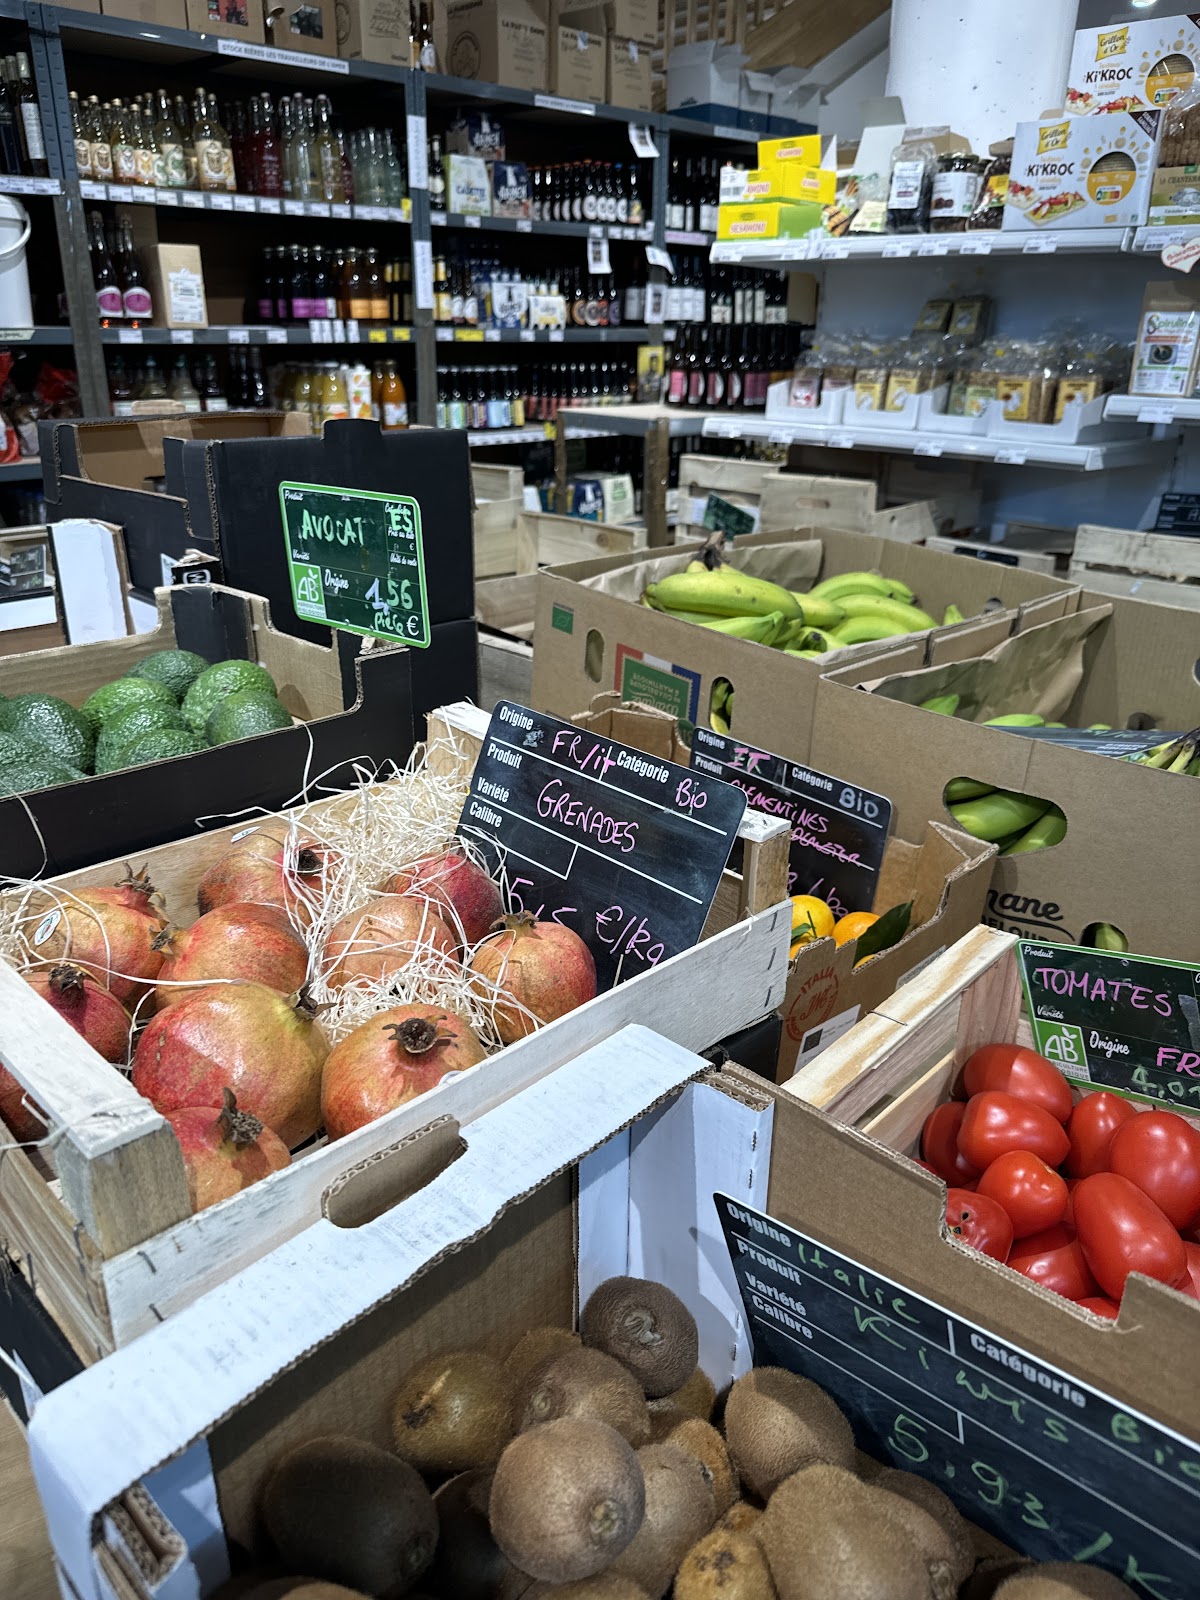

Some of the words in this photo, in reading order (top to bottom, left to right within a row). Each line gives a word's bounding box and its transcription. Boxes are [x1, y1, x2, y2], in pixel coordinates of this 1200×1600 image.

[301, 509, 368, 546] AVOCAT
[390, 508, 413, 533] ES
[297, 576, 319, 602] AB
[406, 615, 420, 636] €
[486, 743, 523, 769] Produit
[499, 706, 534, 731] Origine
[616, 750, 670, 783] Catégorie
[697, 730, 725, 750] Origine
[791, 766, 833, 792] Catégorie
[695, 755, 723, 775] Produit
[477, 777, 510, 803] Variété
[469, 801, 502, 828] Calibre
[537, 779, 639, 853] GRENADES
[1024, 945, 1054, 959] Produit
[1035, 967, 1173, 1017] TOMATES
[1037, 1005, 1064, 1020] Variété
[1044, 1033, 1079, 1062] AB
[1089, 1030, 1130, 1058] Origine
[1156, 1046, 1200, 1078] FR
[736, 1236, 803, 1286] Produit
[726, 1201, 792, 1248] Origine
[969, 1331, 1087, 1409] Catégorie
[744, 1270, 808, 1318] Variété
[751, 1295, 814, 1341] Calibre
